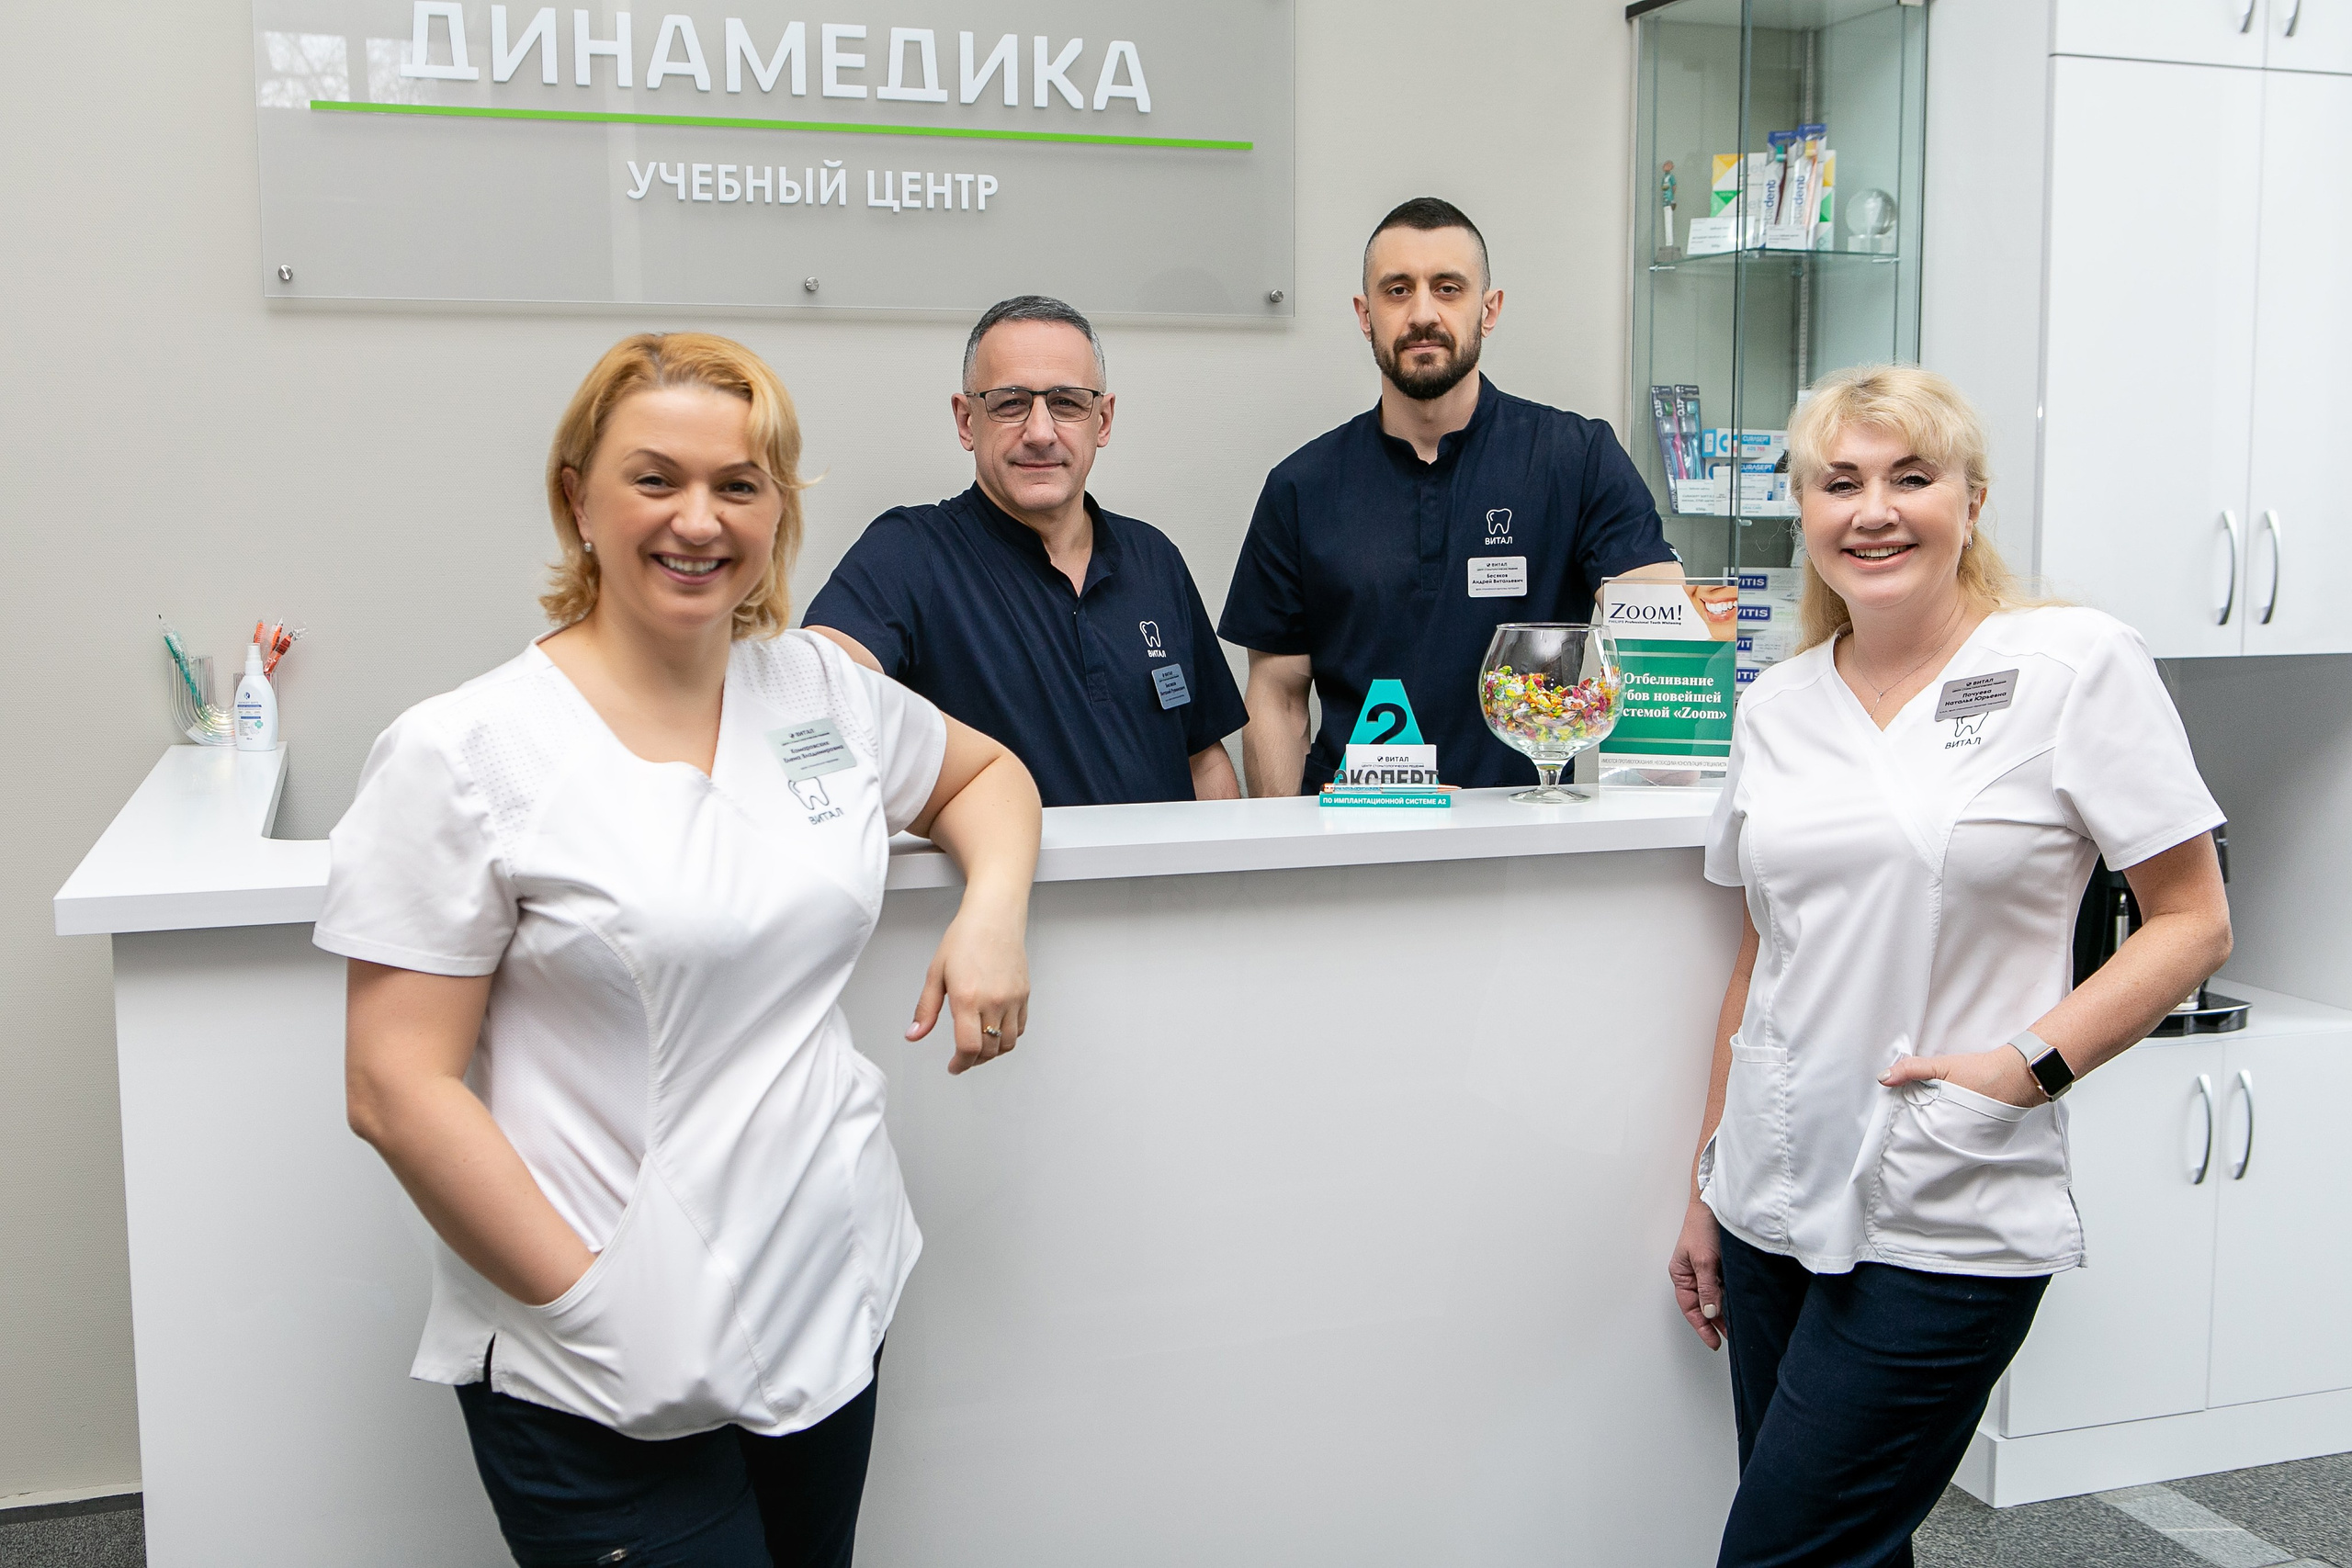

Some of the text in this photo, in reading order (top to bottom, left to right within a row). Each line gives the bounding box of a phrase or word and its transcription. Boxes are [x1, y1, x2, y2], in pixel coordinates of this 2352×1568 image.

[400, 0, 1152, 114] ДИНАМЕДИКА
[626, 160, 999, 213] УЧЕБНЫЙ ЦЕНТР
[1485, 536, 1513, 546] ВИТАЛ
[1609, 603, 1682, 621] ZOOM!
[1147, 649, 1167, 658] ВИТАЛ
[1623, 671, 1714, 686] Отбеливание
[1973, 678, 1994, 686] ВИТАЛ
[1624, 689, 1722, 703] бов новейшей
[1944, 692, 2007, 706] Наталья Юрьевна
[1962, 689, 1993, 698] Почуева
[1622, 706, 1727, 719] стемой «Zoom»
[1365, 702, 1408, 745] 2
[1944, 737, 1982, 750] ВИТАЛ
[1333, 796, 1405, 806] ИМПЛАНТАЦИОННОЙ
[808, 807, 844, 826] ВИТАЛ
